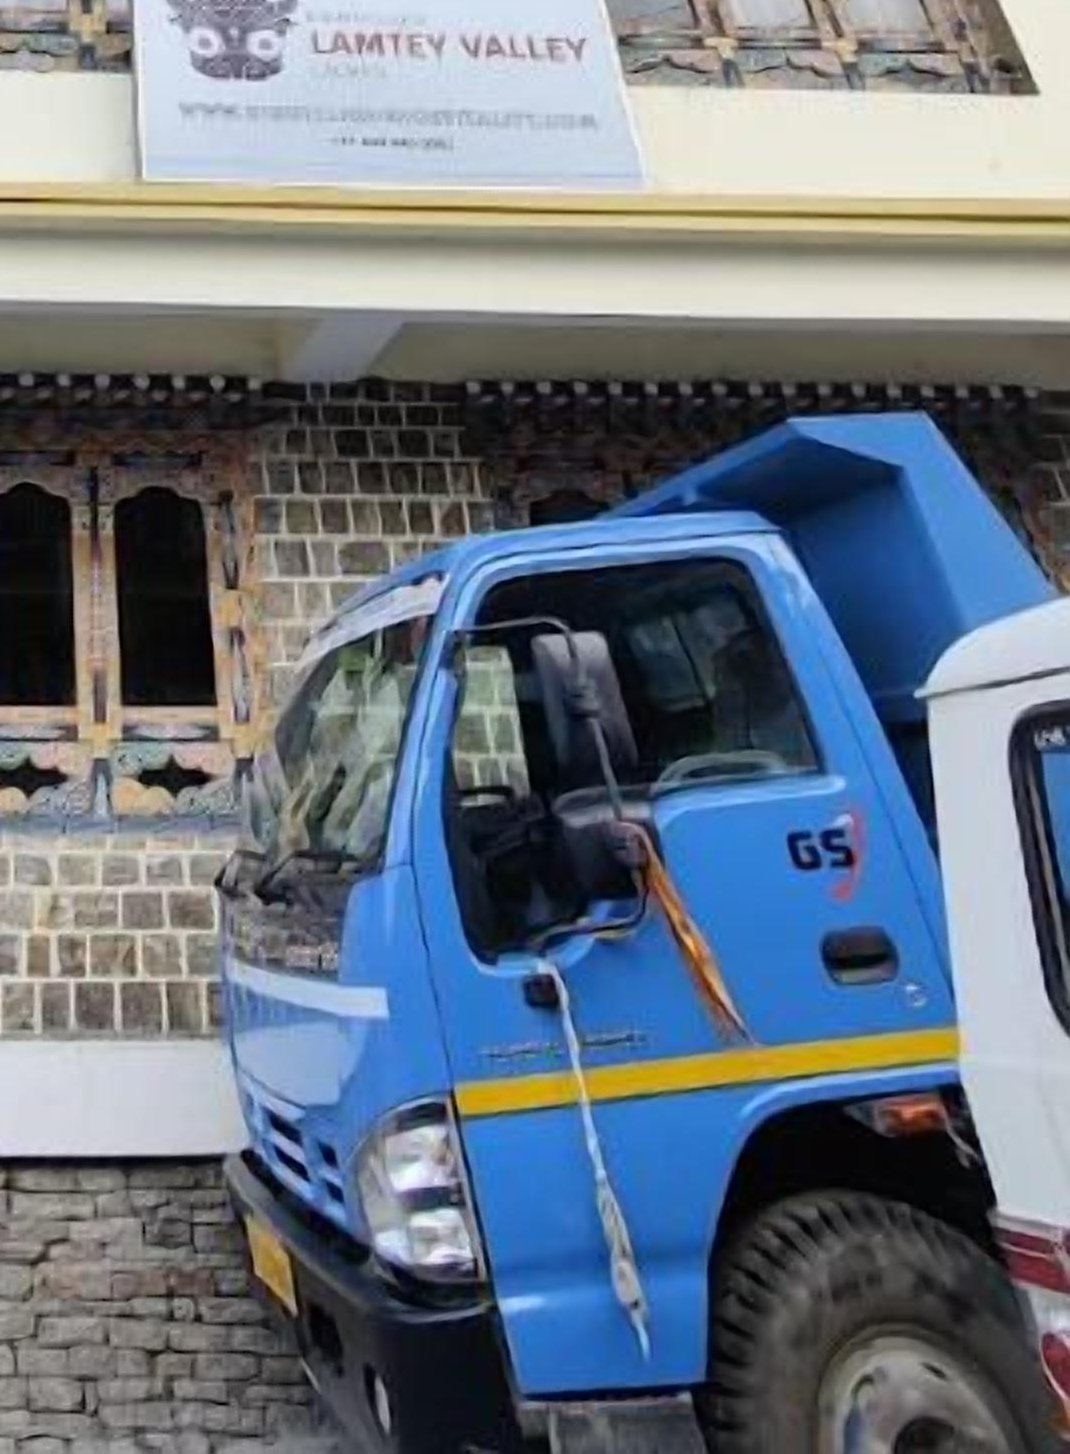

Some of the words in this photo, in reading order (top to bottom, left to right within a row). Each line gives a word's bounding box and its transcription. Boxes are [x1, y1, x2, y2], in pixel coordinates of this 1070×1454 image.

[310, 30, 446, 60] LAMTEY
[459, 34, 587, 61] VALLEY
[787, 828, 856, 871] GS
